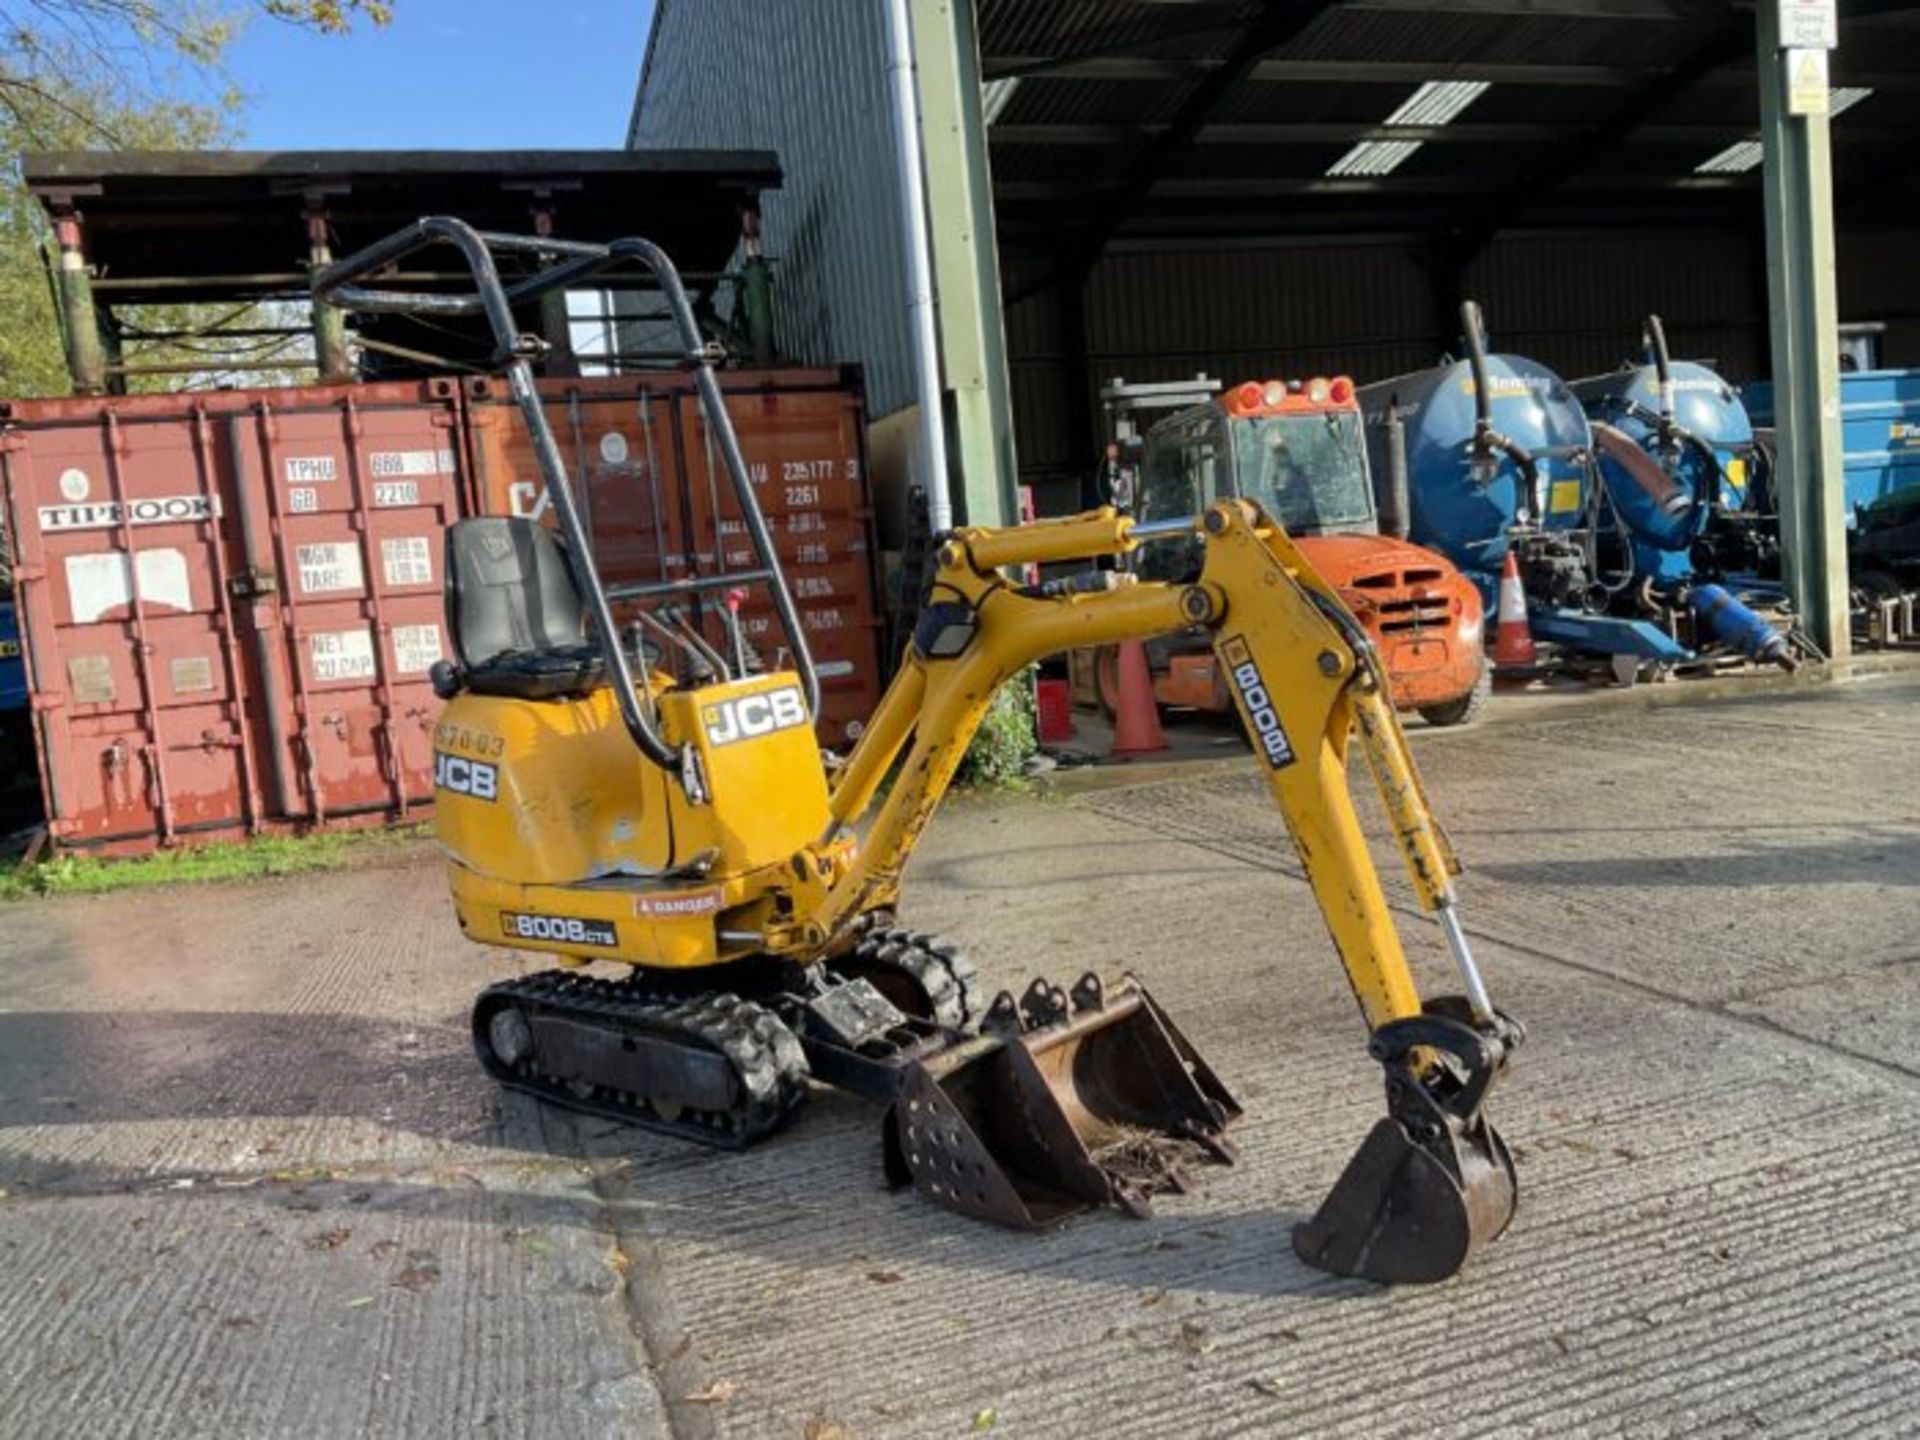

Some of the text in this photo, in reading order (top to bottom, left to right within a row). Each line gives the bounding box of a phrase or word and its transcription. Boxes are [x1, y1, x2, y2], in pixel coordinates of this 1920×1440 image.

[288, 458, 334, 480] TPHU
[709, 688, 804, 745] JCB
[436, 754, 497, 799] JCB
